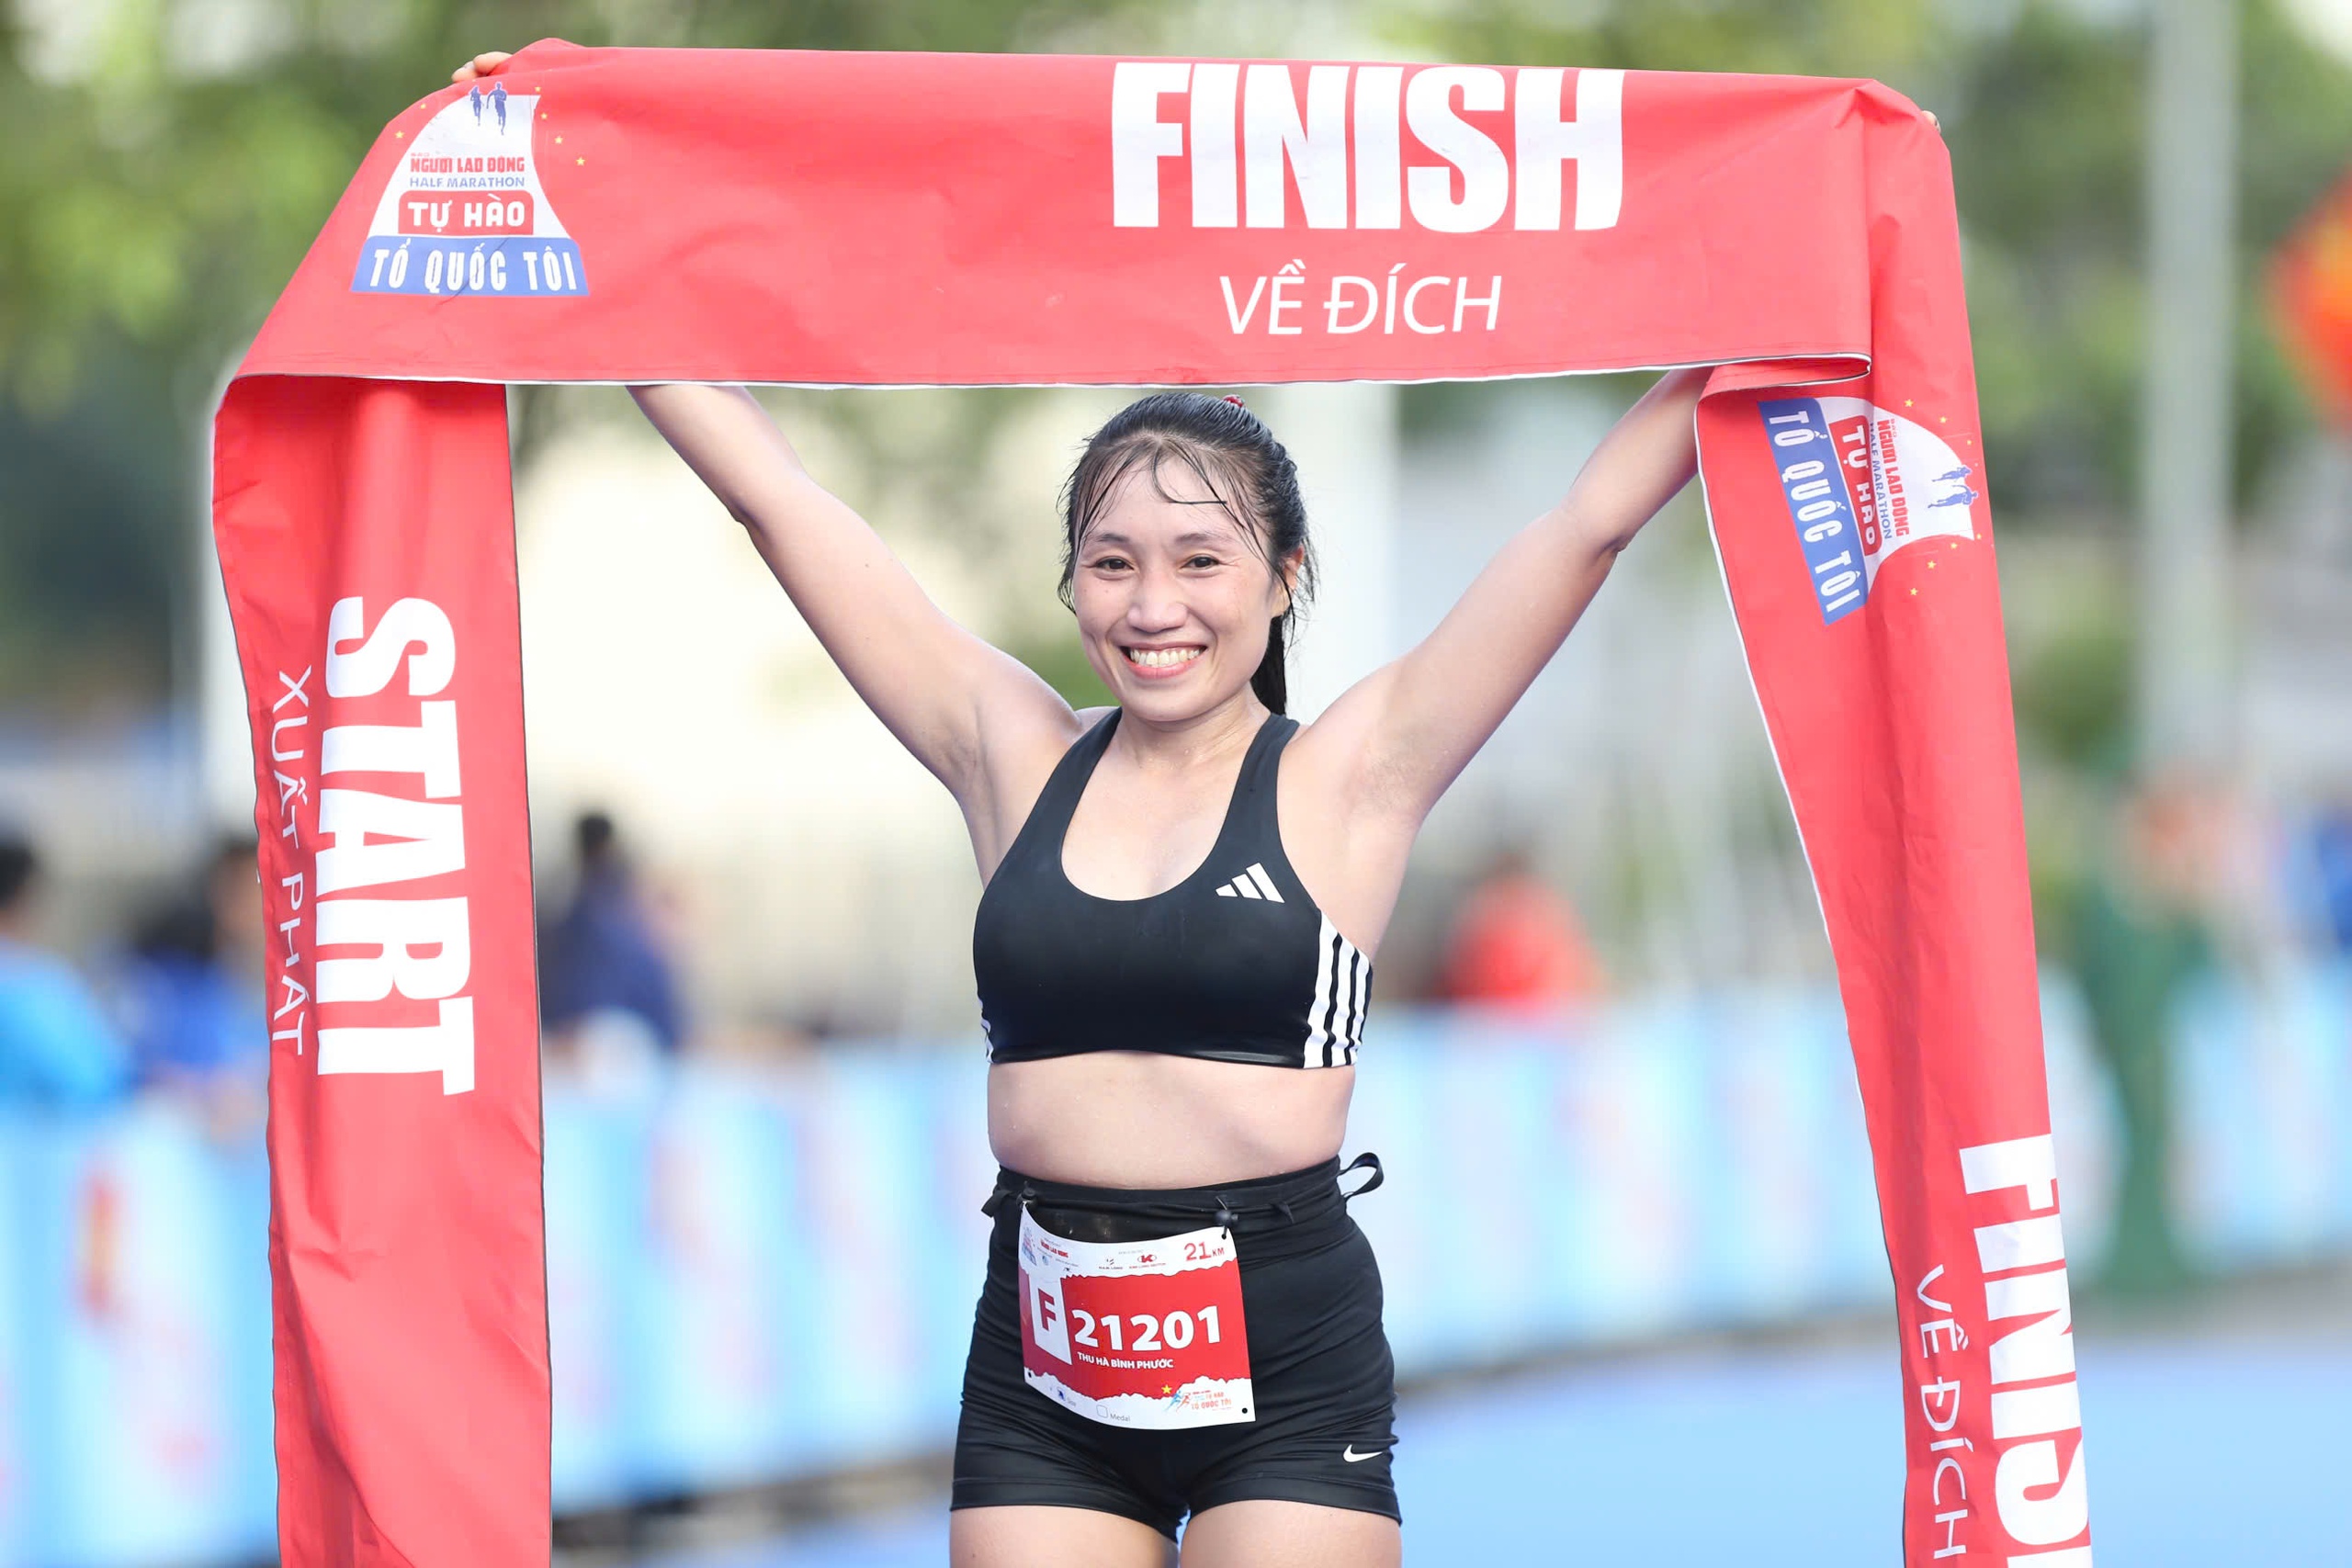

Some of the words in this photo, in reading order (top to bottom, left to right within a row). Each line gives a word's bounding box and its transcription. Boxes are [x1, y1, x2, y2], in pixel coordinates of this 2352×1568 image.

[410, 177, 443, 187] HALF
[447, 177, 525, 187] MARATHON
[458, 157, 483, 173] LAO
[1112, 62, 1625, 233] FINISH
[407, 199, 453, 232] TỰ
[464, 193, 526, 227] HÀO
[369, 238, 412, 288] TỔ
[424, 242, 507, 294] QUỐC
[523, 245, 577, 291] TÔI
[1220, 259, 1306, 335] VỀ
[1323, 263, 1502, 335] ĐÍCH
[1769, 411, 1828, 447] TỔ
[1842, 424, 1869, 468] TỰ
[1781, 460, 1847, 543] QUỐC
[1872, 460, 1892, 539] MARATHON
[1815, 550, 1860, 613] TÔI
[271, 665, 313, 850] XUẤT
[315, 596, 476, 1096] START
[272, 872, 311, 1055] PHÁT
[1071, 1305, 1221, 1351] 21201
[1917, 1264, 1969, 1359] VỀ
[1077, 1351, 1094, 1363] THU
[1096, 1356, 1110, 1367] HÀ
[1111, 1359, 1135, 1369] BÌNH
[1136, 1359, 1174, 1369] PHƯỚC
[1959, 1134, 2093, 1568] FINIS
[1920, 1376, 1973, 1559] ĐÍCH
